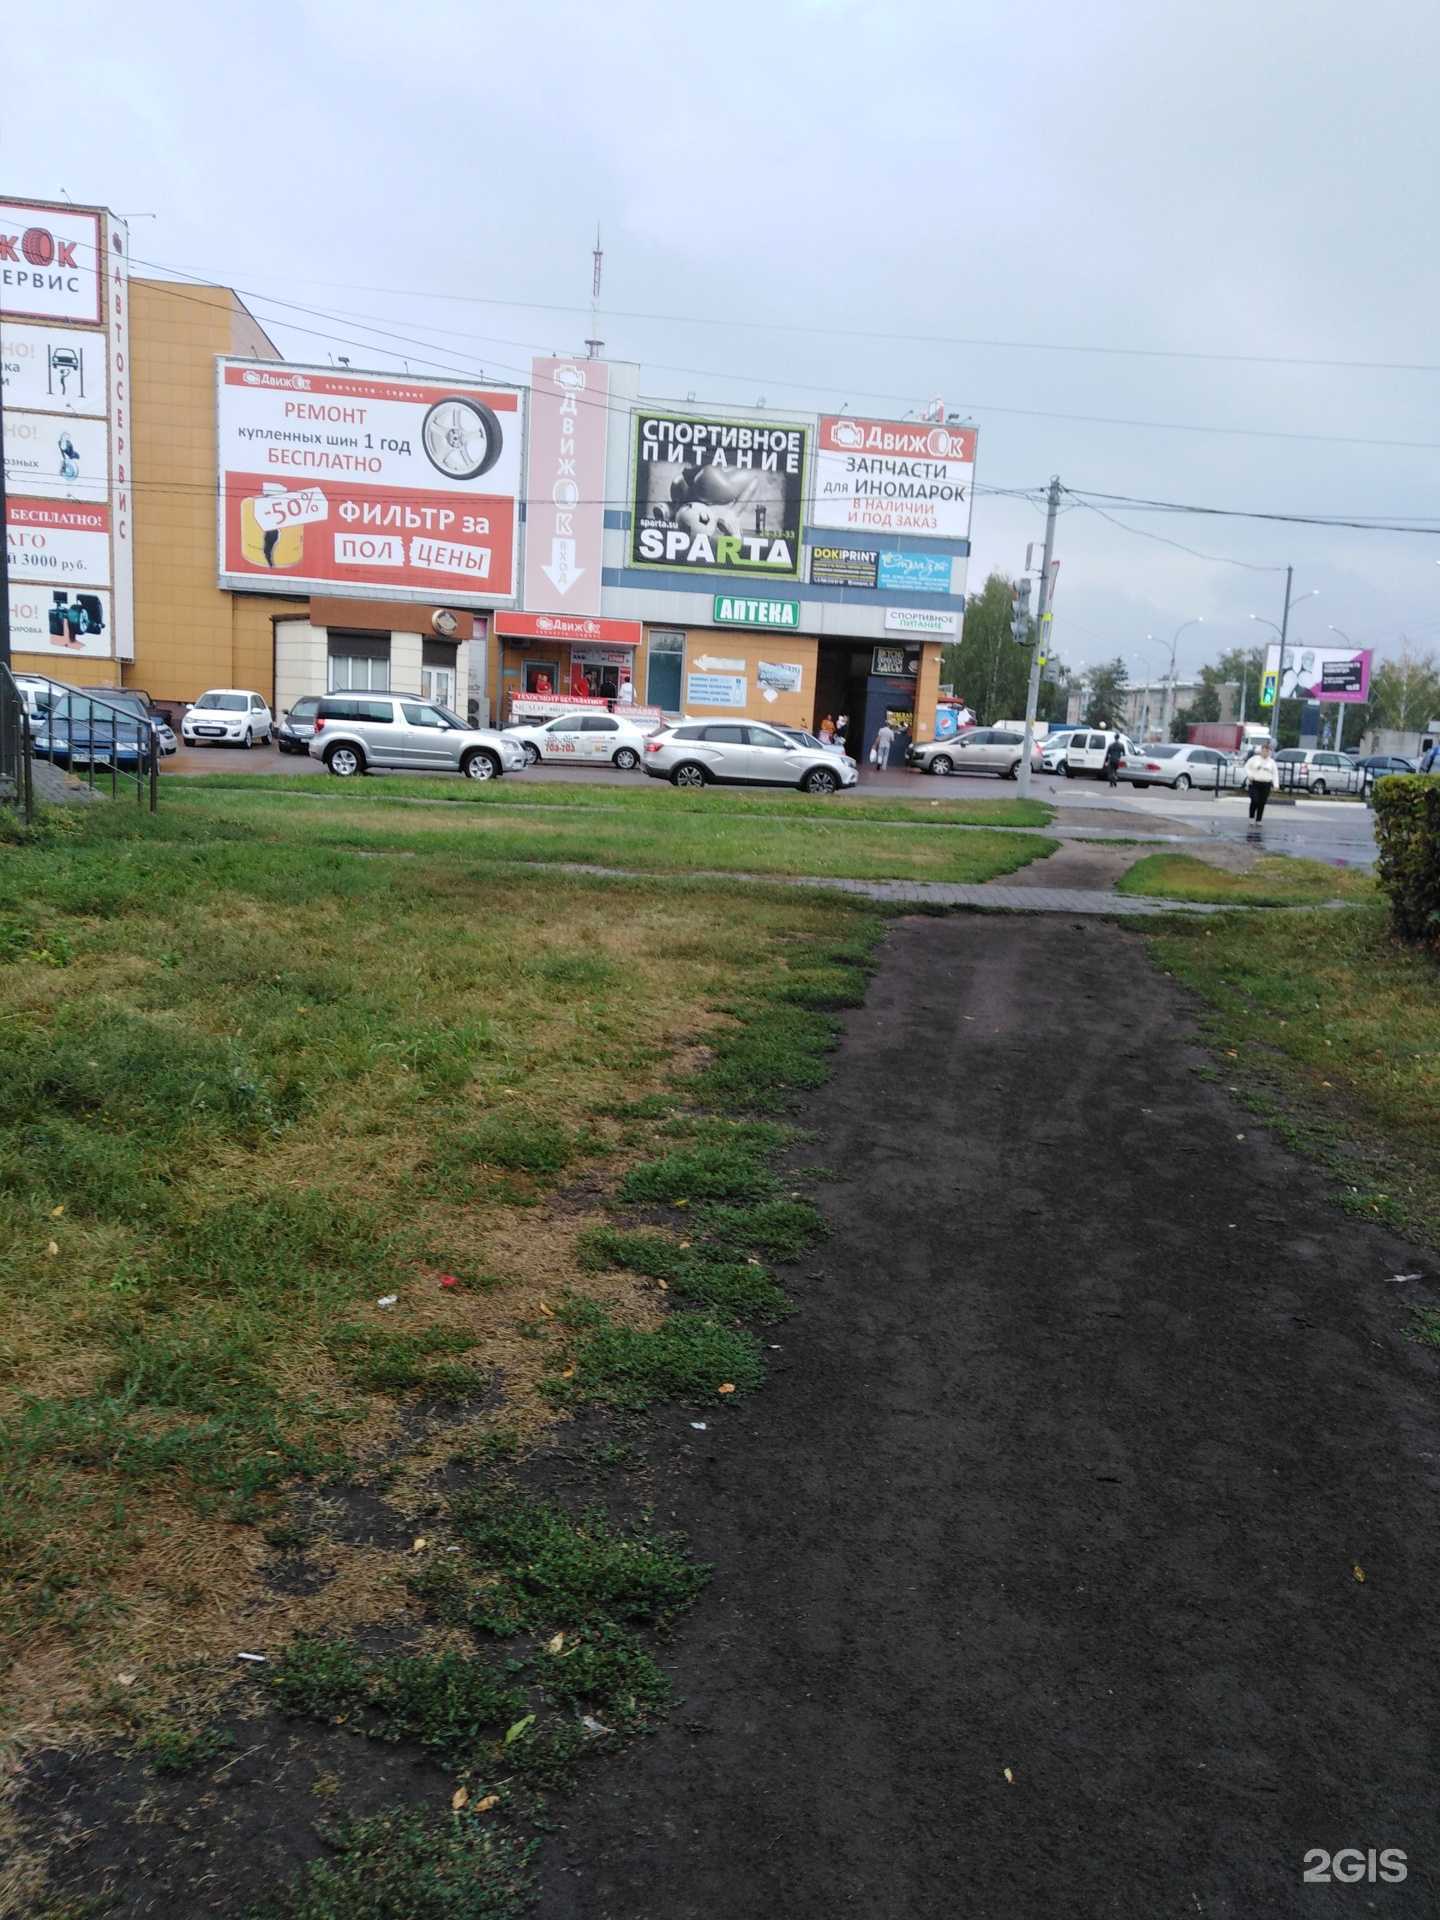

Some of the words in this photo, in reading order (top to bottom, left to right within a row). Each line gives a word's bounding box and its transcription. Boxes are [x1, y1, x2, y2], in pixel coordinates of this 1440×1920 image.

[112, 266, 127, 540] АВТОСЕРВИС
[284, 401, 367, 425] РЕМОНТ
[238, 426, 322, 445] купленных
[326, 435, 358, 448] шин
[364, 433, 373, 449] 1
[380, 438, 412, 456] год
[642, 420, 800, 452] СПОРТИВНОЕ
[268, 447, 382, 473] БЕСПЛАТНО
[642, 443, 799, 474] ПИТАНИЕ
[846, 457, 947, 480] ЗАПЧАСТИ
[823, 481, 848, 494] для
[855, 479, 966, 502] ИНОМАРОК
[10, 508, 102, 527] БЕСПЛАТНО!
[264, 490, 319, 525] -50%
[339, 501, 455, 528] ФИЛЬТР
[462, 514, 490, 534] за
[853, 497, 861, 509] В
[865, 498, 935, 515] НАЛИЧИИ
[640, 518, 679, 530] sparta.su
[848, 511, 858, 523] И
[863, 513, 891, 528] ПОД
[896, 514, 938, 529] ЗАКАЗ
[342, 540, 393, 559] ПОЛ
[418, 544, 486, 571] ЦЕНЫ
[638, 529, 793, 568] SPARTA
[21, 553, 57, 567] 3000
[61, 560, 87, 571] руб.
[720, 598, 794, 626] АПТЕКА
